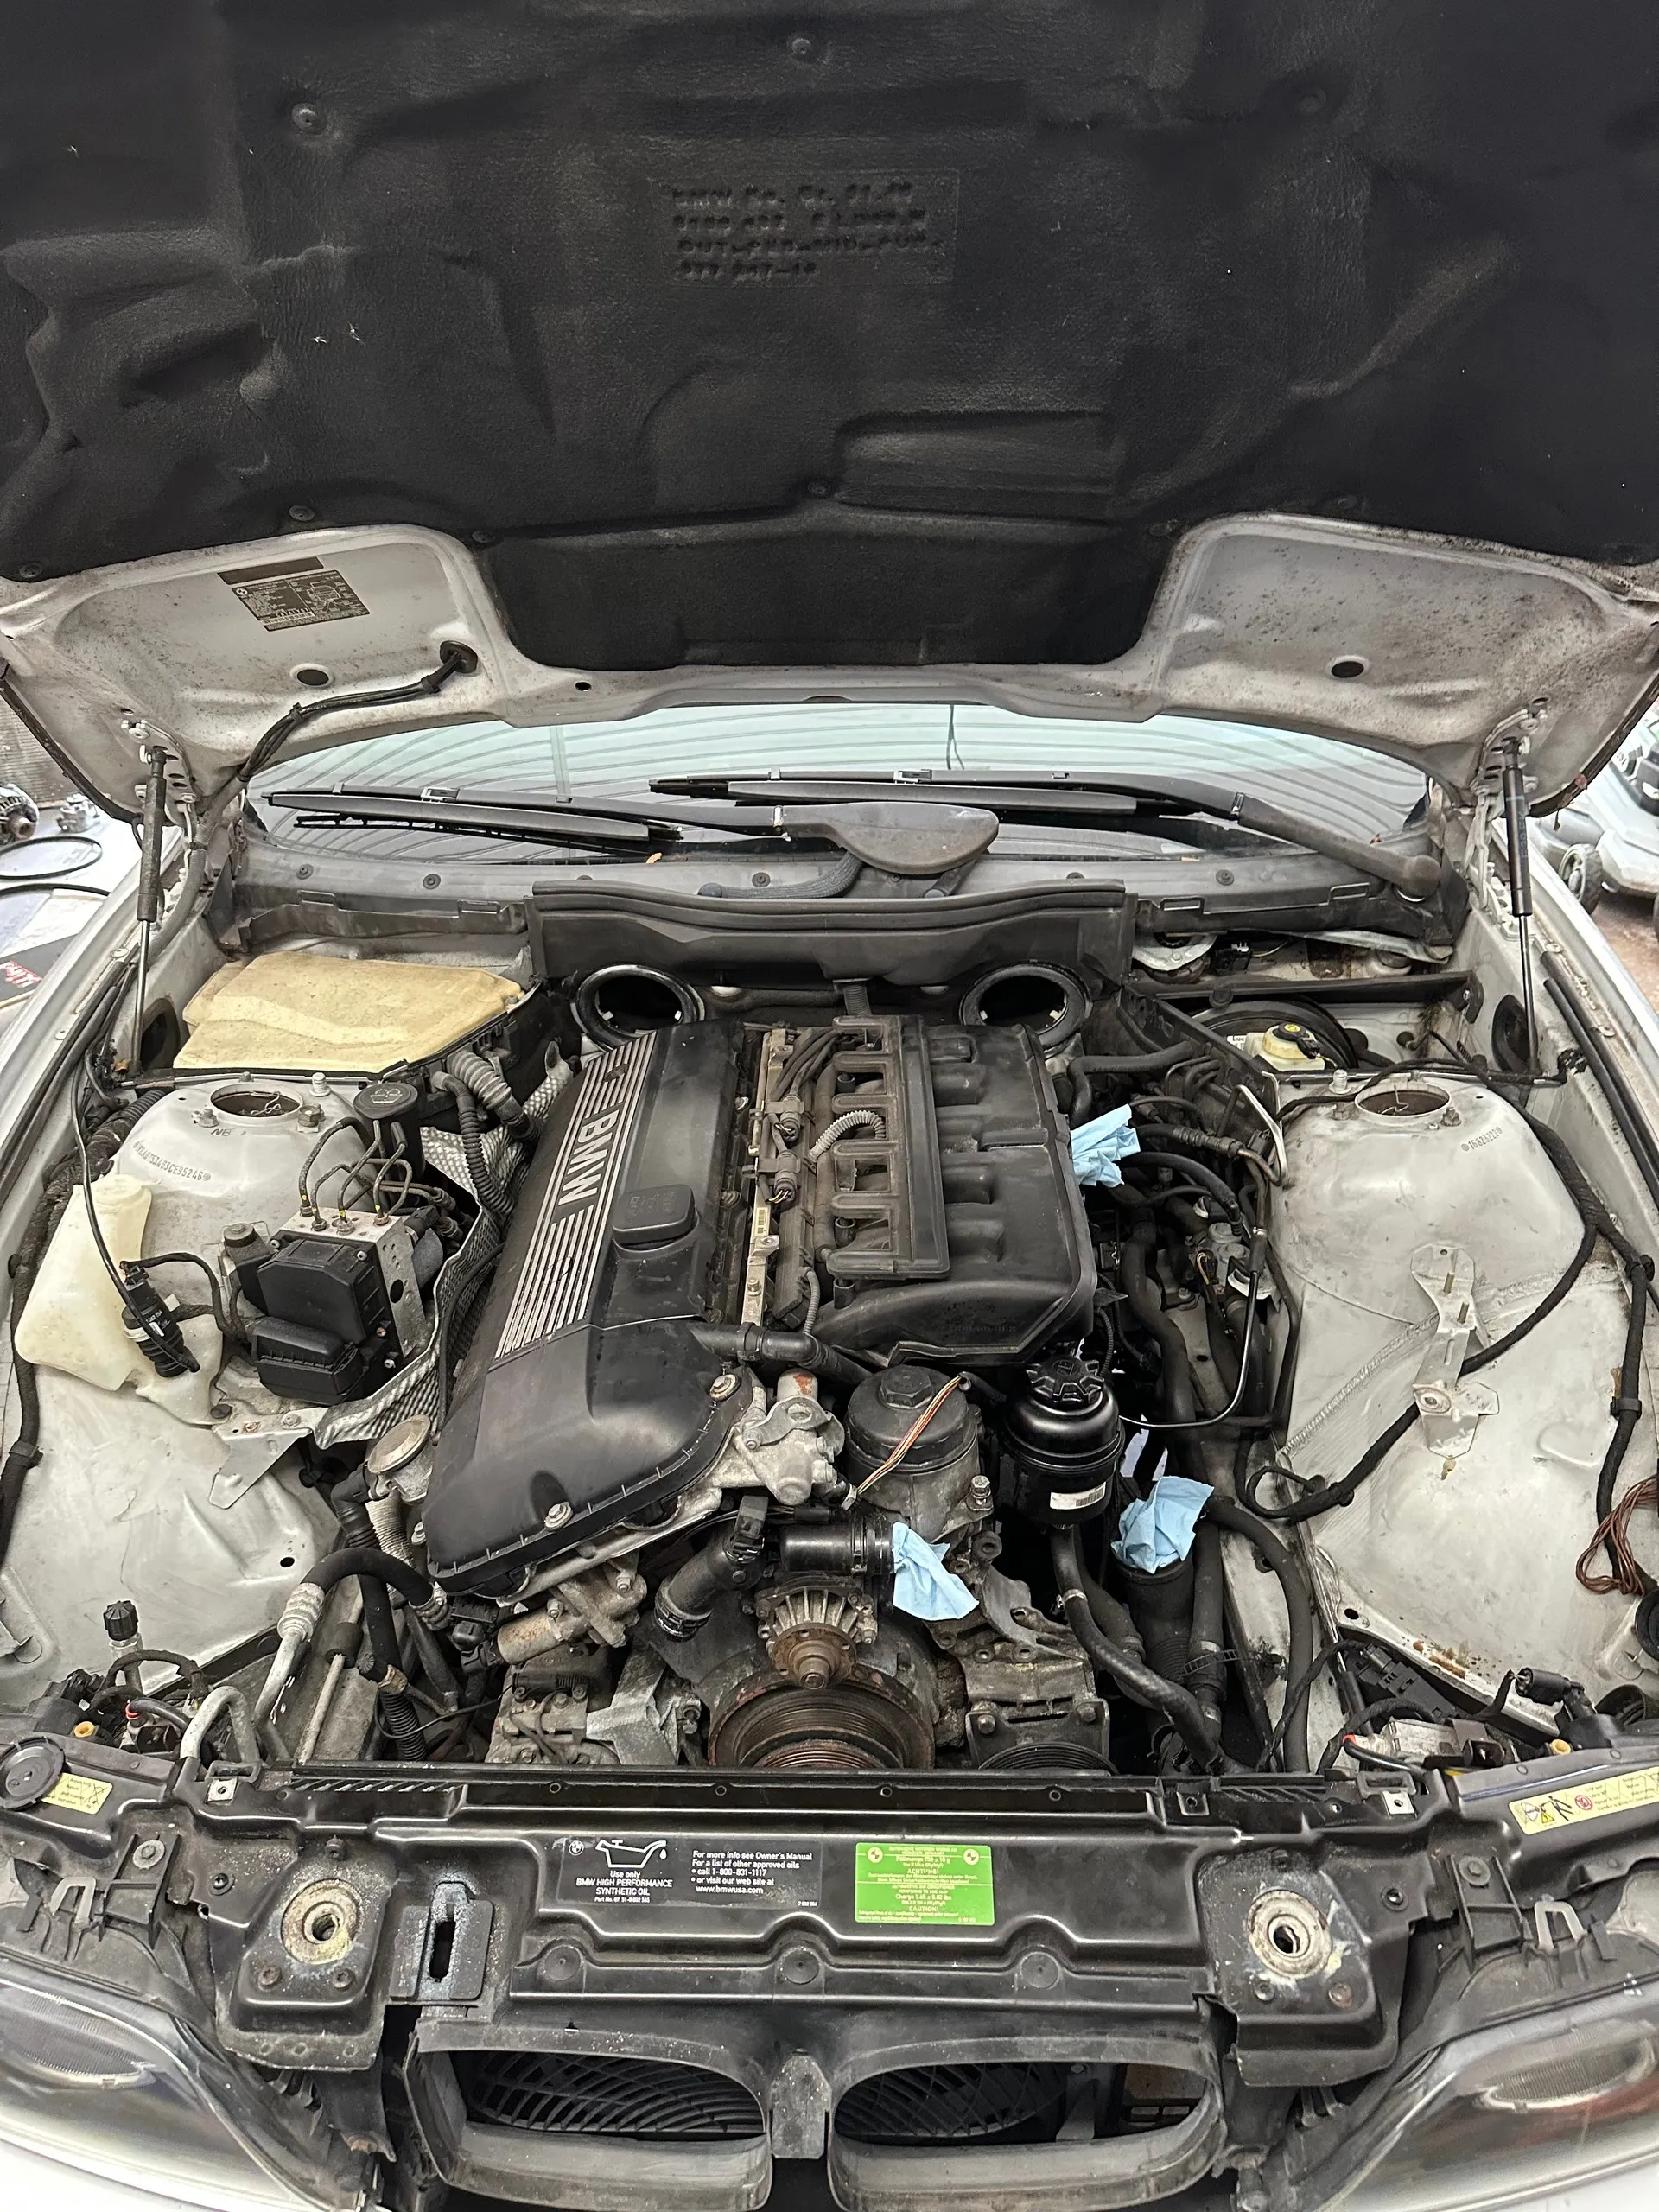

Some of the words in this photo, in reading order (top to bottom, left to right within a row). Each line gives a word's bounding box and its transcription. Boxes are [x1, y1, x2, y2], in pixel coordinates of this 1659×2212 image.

[557, 1109, 620, 1205] BMW
[693, 1850, 706, 1859] For
[755, 1851, 785, 1859] Owner's
[785, 1852, 813, 1860] Manual
[692, 1859, 705, 1867] For
[711, 1859, 723, 1867] list
[732, 1859, 753, 1868] other
[752, 1860, 785, 1869] approved
[786, 1860, 800, 1869] oils
[610, 1870, 625, 1878] Use
[625, 1870, 641, 1879] only
[712, 1867, 767, 1877] 1-800-831-1117
[575, 1878, 596, 1886] BMW
[616, 1878, 673, 1888] PERFORMANCE
[706, 1876, 721, 1885] visit
[735, 1877, 752, 1885] web
[752, 1877, 766, 1885] site
[595, 1887, 637, 1896] SYNTHETIC
[696, 1885, 764, 1894] www.bmwusa.com
